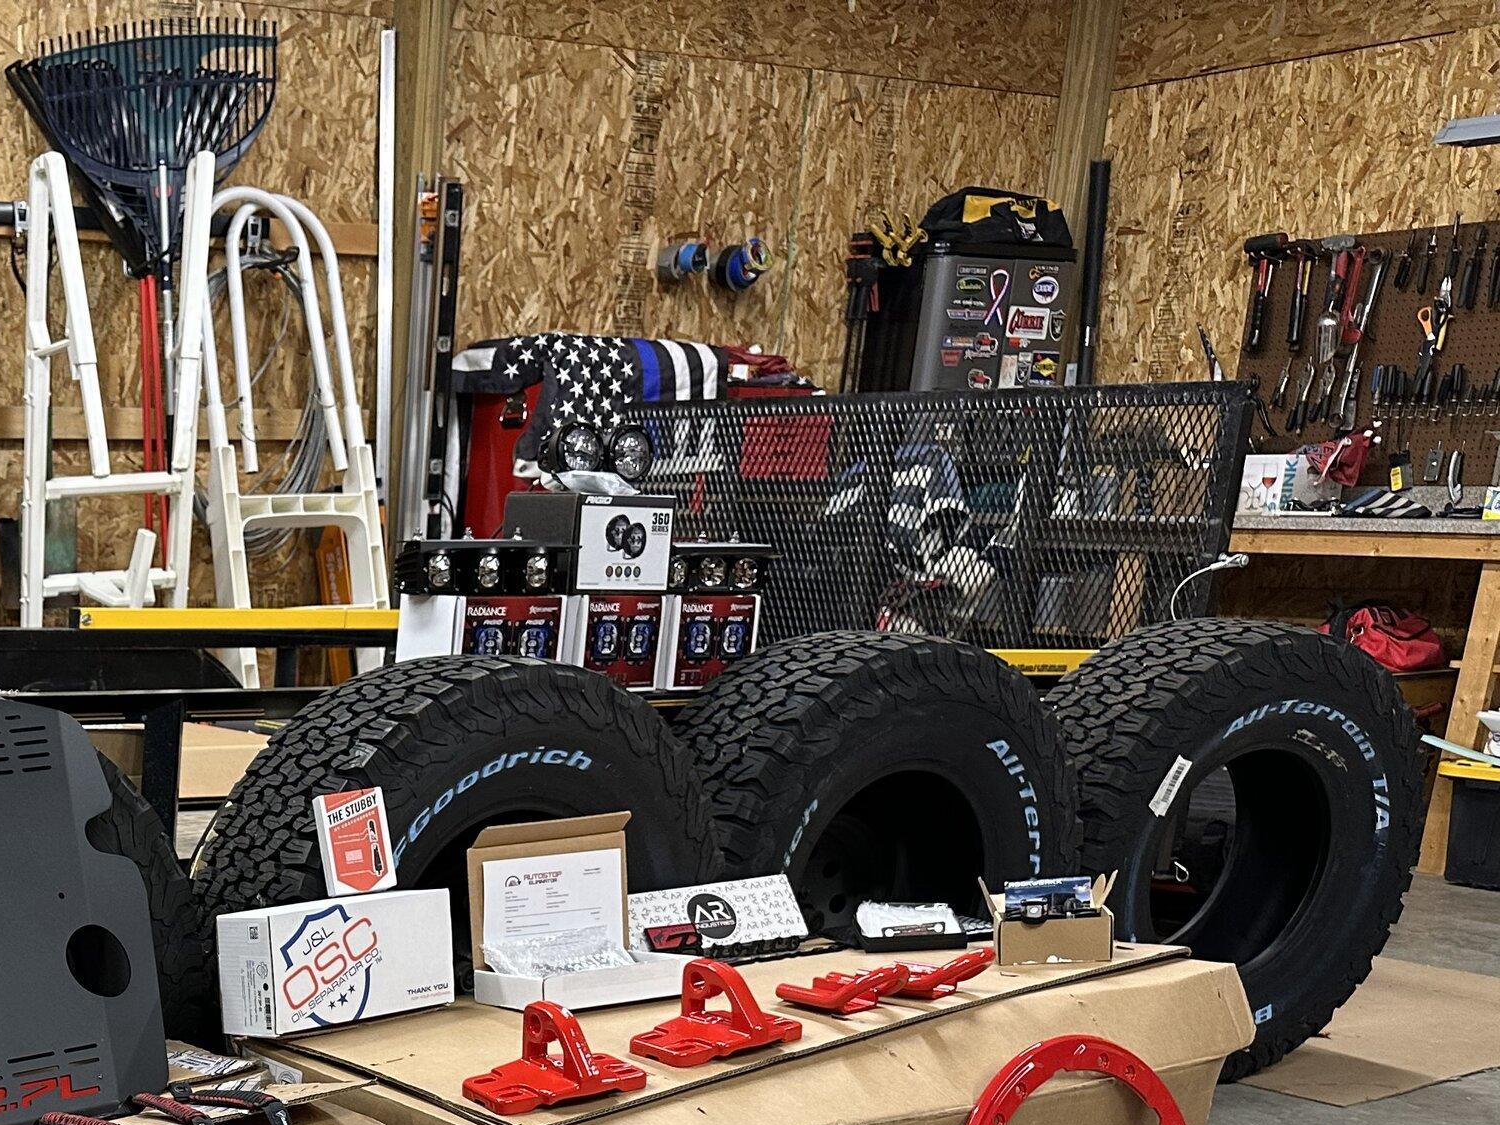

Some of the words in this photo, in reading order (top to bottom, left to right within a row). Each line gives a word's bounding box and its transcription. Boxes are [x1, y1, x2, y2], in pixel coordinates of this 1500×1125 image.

[585, 495, 613, 505] RIGID
[652, 512, 671, 526] 360
[651, 525, 669, 533] SERIES
[467, 606, 507, 617] RADIANCE
[589, 602, 621, 613] RADIANCE
[682, 602, 714, 613] RADIANCE
[1222, 698, 1376, 761] All-Terrain
[1372, 773, 1391, 832] T/A
[327, 808, 344, 826] THE
[345, 792, 378, 818] STUBBY
[392, 745, 593, 870] FGoodrich
[986, 739, 1041, 876] All-Terr
[523, 870, 563, 881] AUTOSTOP
[528, 878, 558, 886] ELIMINATOR
[694, 900, 732, 924] AR
[695, 918, 736, 931] INDUSTRIES
[302, 926, 335, 957] J&L
[282, 916, 379, 1011] OSC
[290, 1008, 308, 1025] OIL
[308, 961, 364, 1011] SEPARATOR
[406, 985, 432, 996] THANK
[433, 983, 449, 993] YOU
